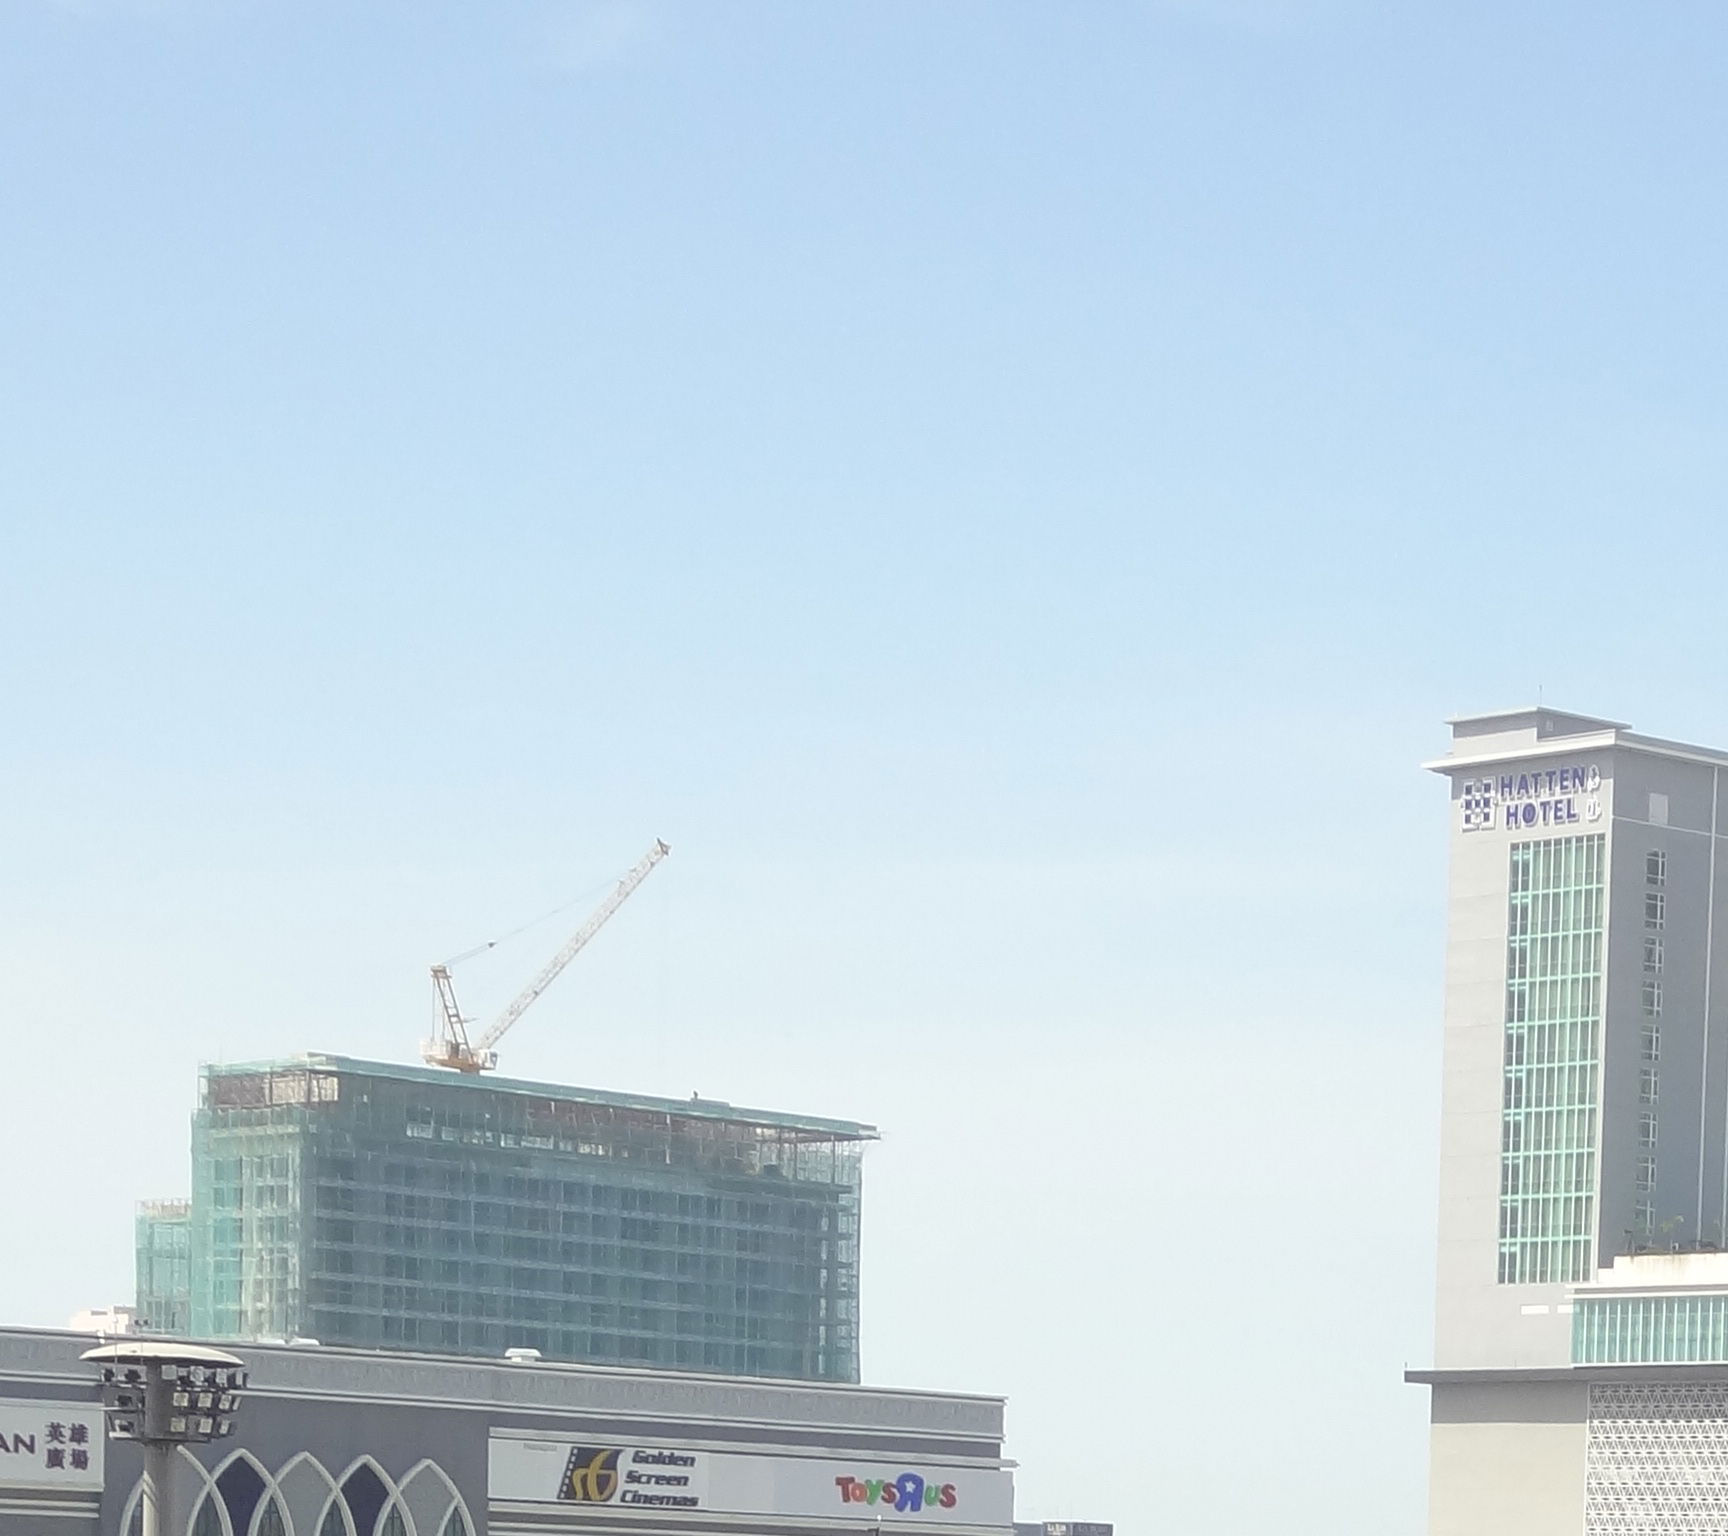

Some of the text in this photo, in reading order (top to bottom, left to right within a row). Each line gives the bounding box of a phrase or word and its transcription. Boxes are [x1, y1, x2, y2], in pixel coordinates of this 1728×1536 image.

[1499, 767, 1586, 801] HATTEN
[1505, 797, 1580, 829] HOTEL
[631, 1449, 696, 1468] Golden
[624, 1469, 690, 1487] Screen
[619, 1489, 700, 1508] Cinemas
